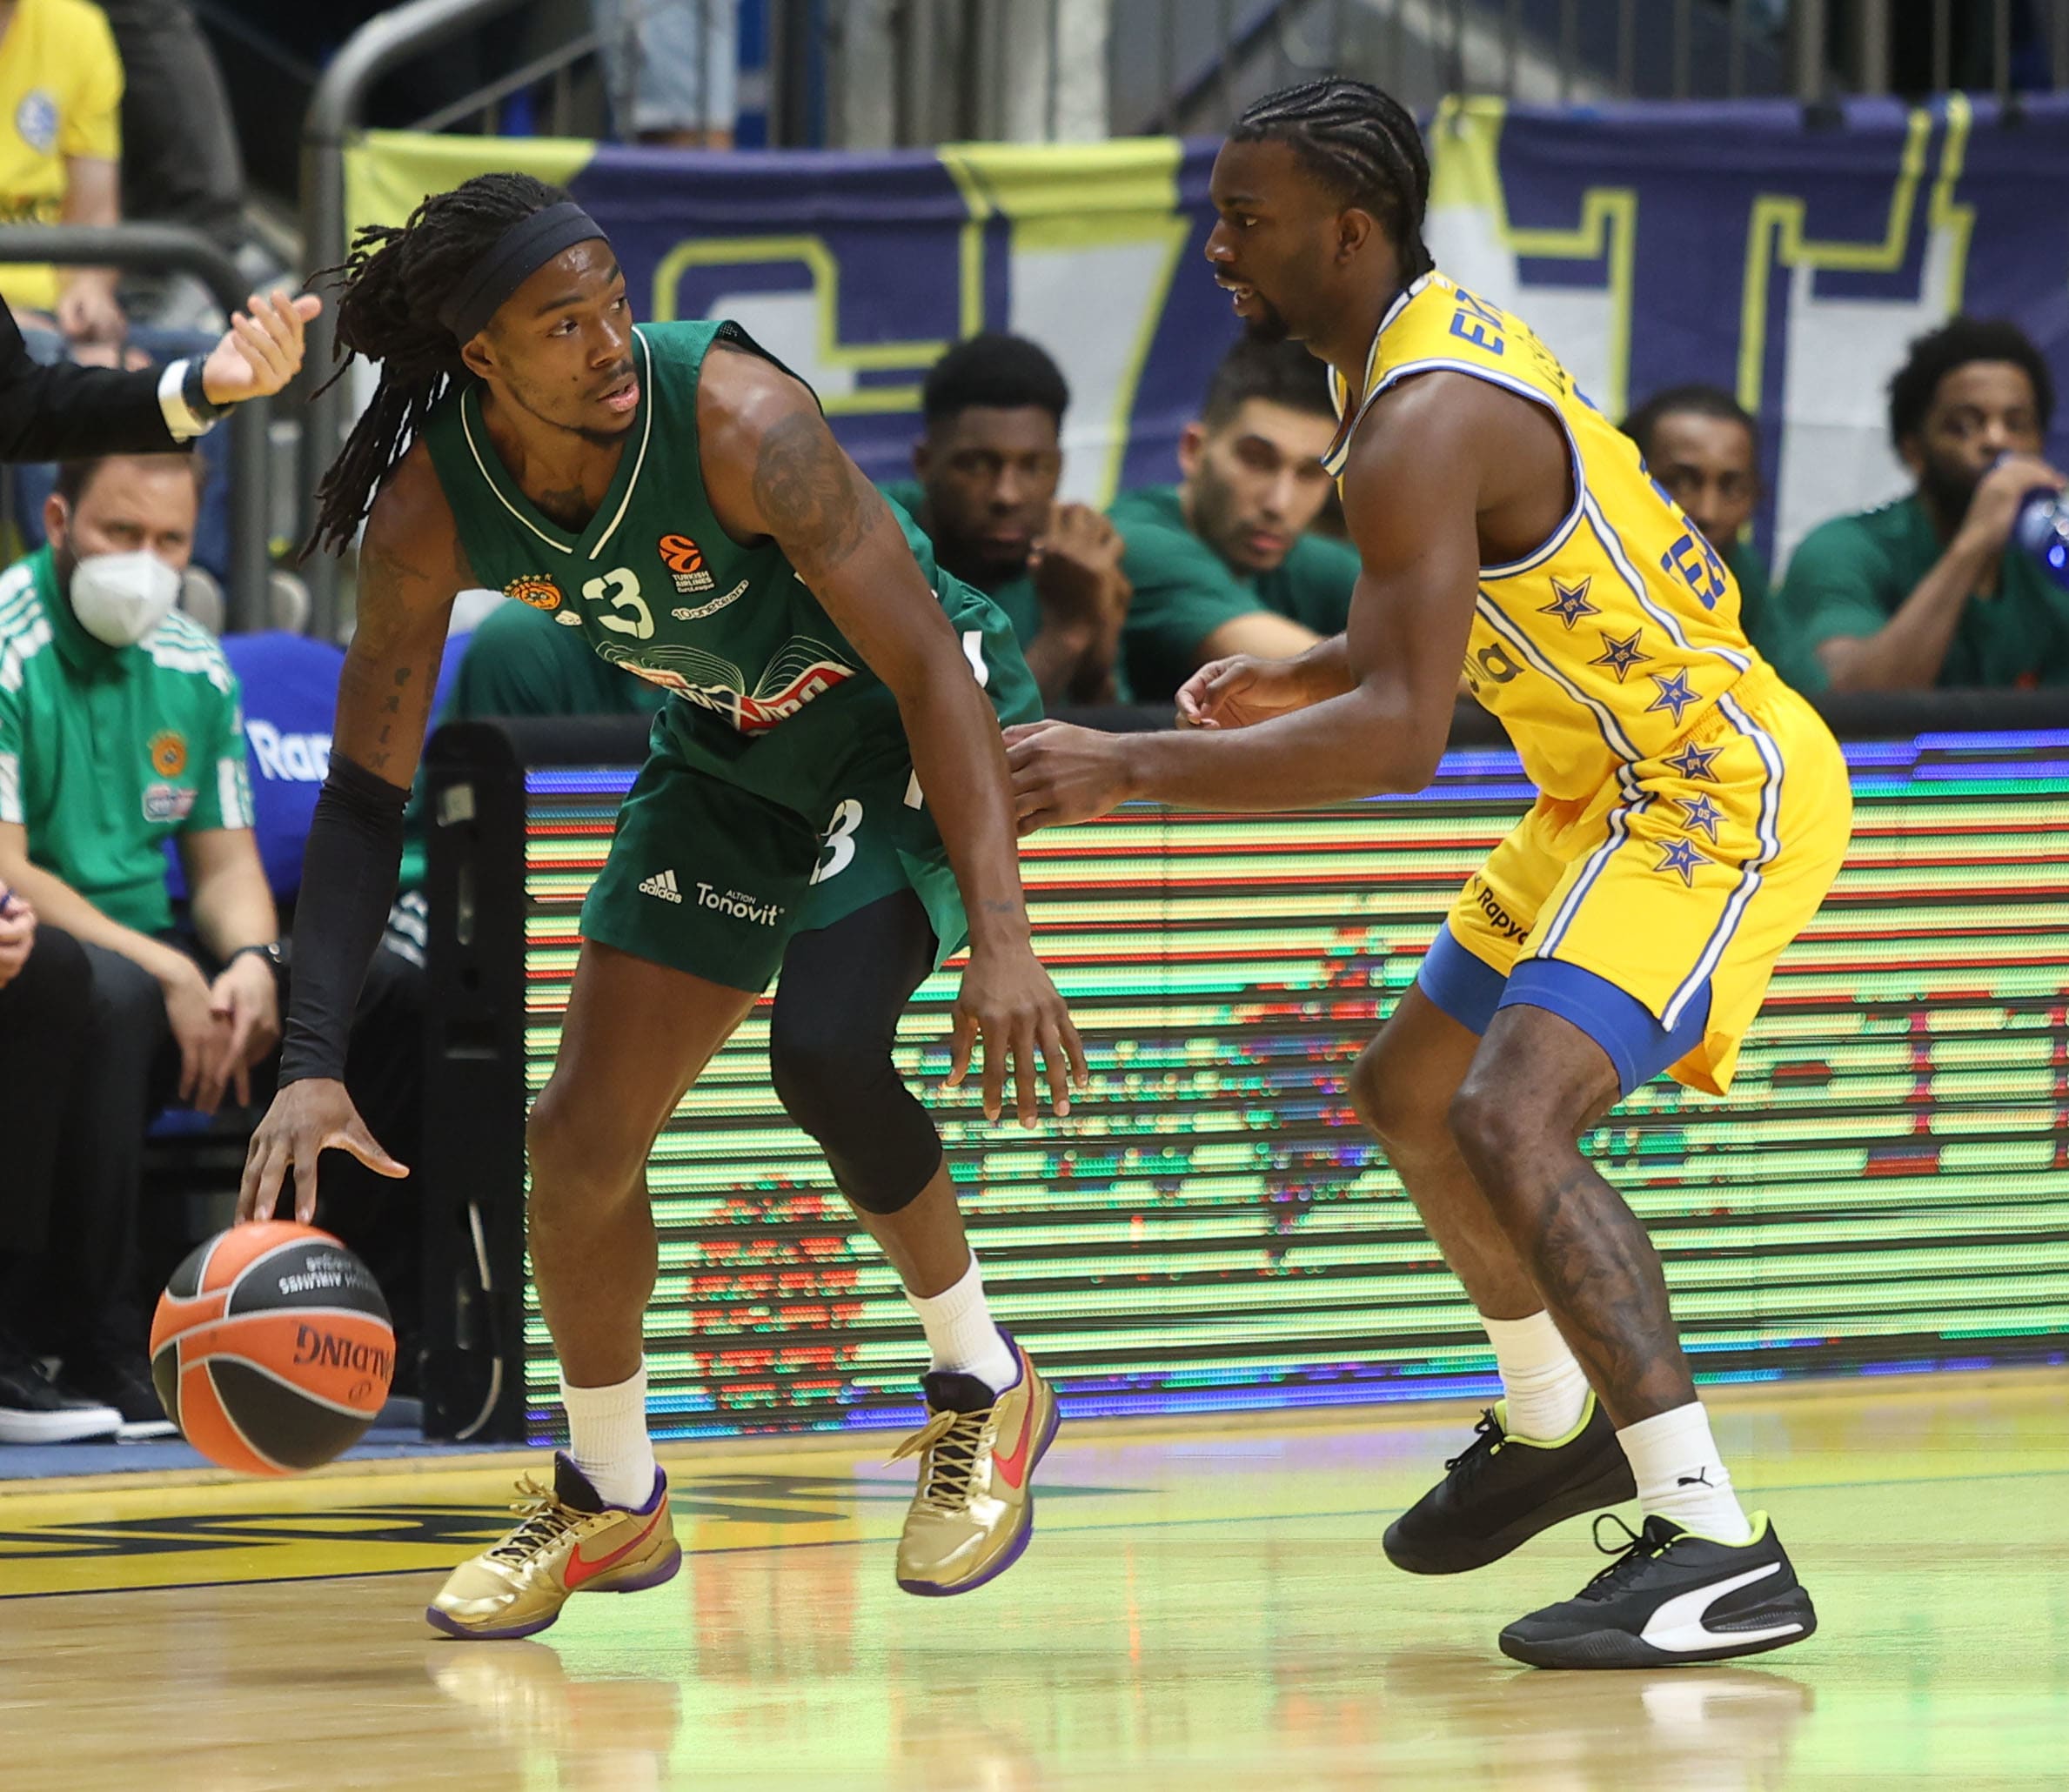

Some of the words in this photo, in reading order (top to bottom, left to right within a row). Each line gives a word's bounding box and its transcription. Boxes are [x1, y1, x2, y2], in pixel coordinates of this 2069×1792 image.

[672, 570, 710, 581] TURKISH
[675, 577, 713, 588] AIRLINES
[581, 566, 655, 640] 3
[639, 882, 683, 905] adidas
[696, 881, 779, 927] Tonovit
[726, 889, 757, 906] ALTION
[292, 1324, 394, 1385] ALDING
